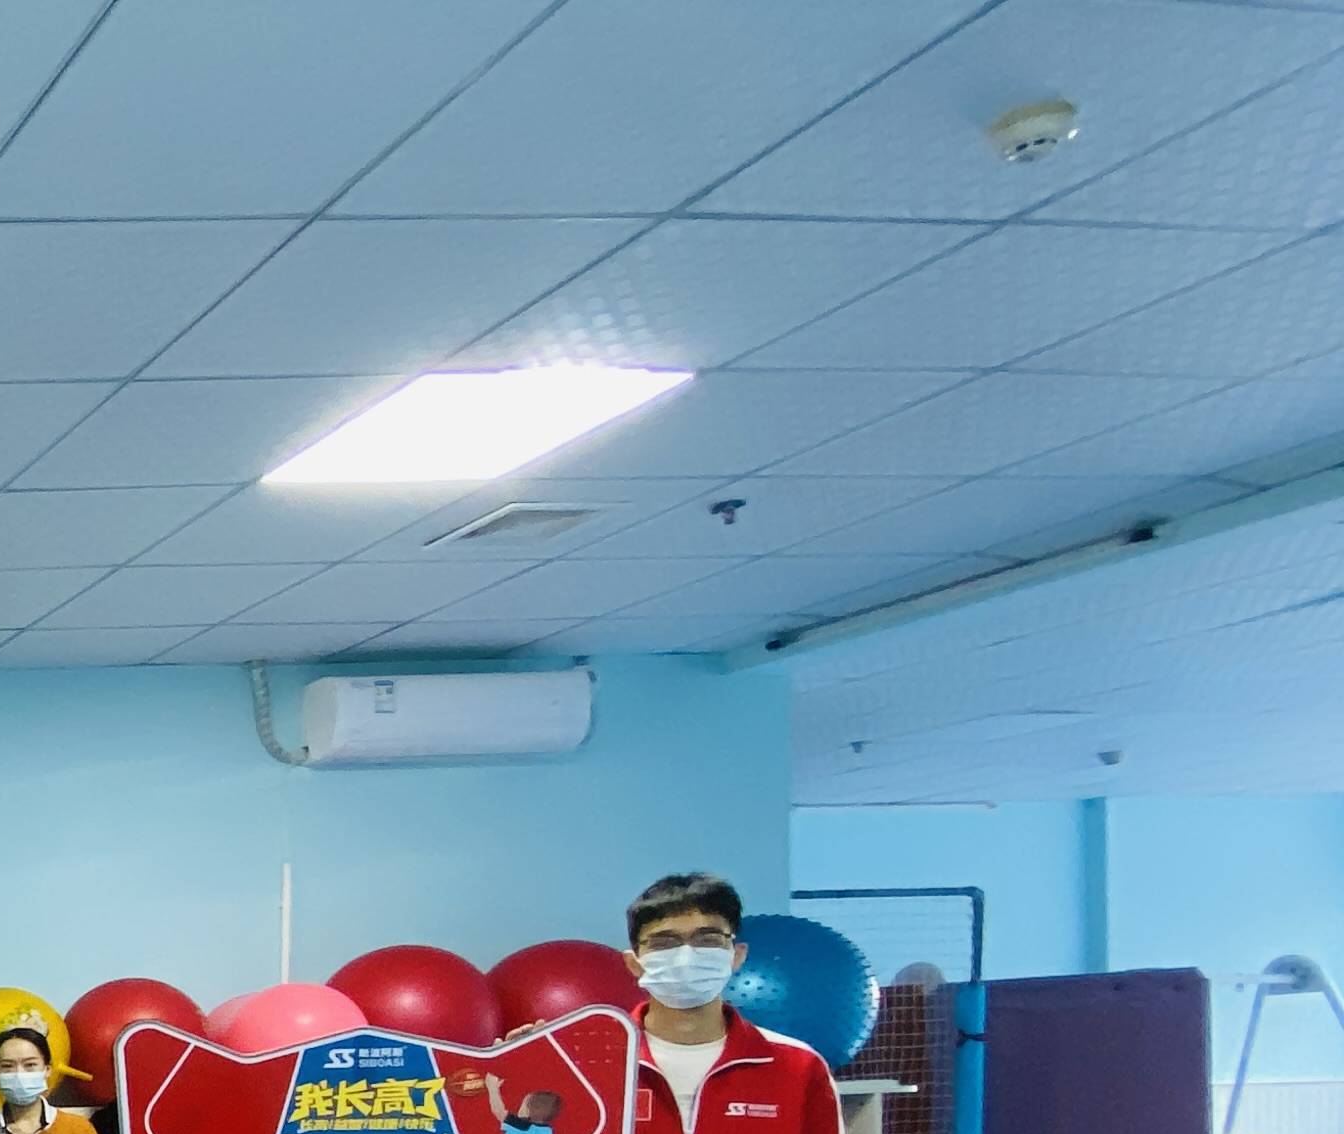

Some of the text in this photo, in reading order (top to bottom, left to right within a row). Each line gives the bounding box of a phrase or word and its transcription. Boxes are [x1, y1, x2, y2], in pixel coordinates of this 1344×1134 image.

[358, 1058, 404, 1068] SIBOASI
[289, 1077, 446, 1123] 我长高了
